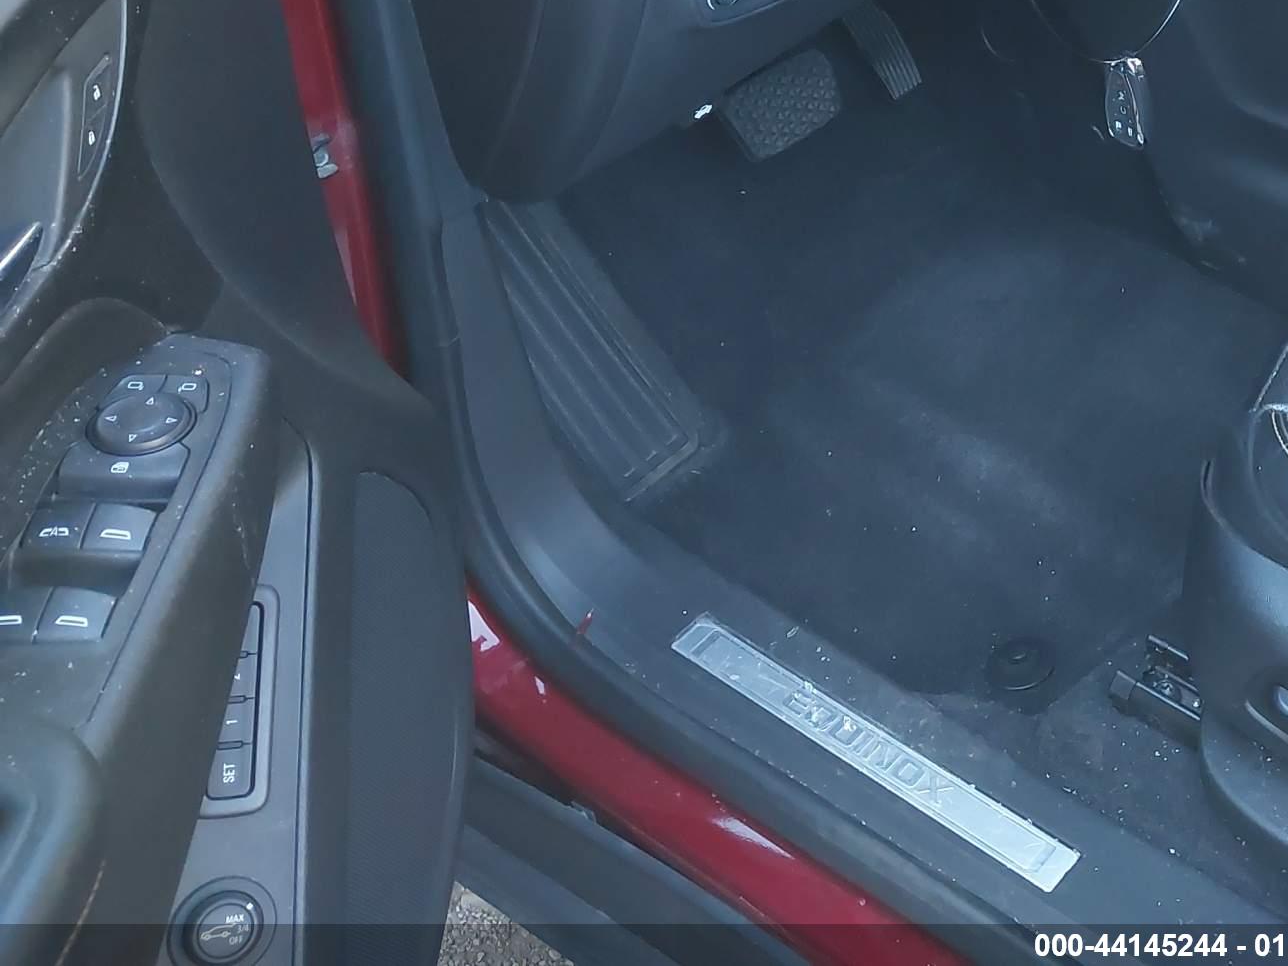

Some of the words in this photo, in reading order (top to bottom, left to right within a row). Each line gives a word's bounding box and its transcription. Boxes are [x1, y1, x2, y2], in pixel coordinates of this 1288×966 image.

[223, 762, 236, 784] SET
[225, 913, 245, 924] MAX
[229, 935, 244, 945] OFF
